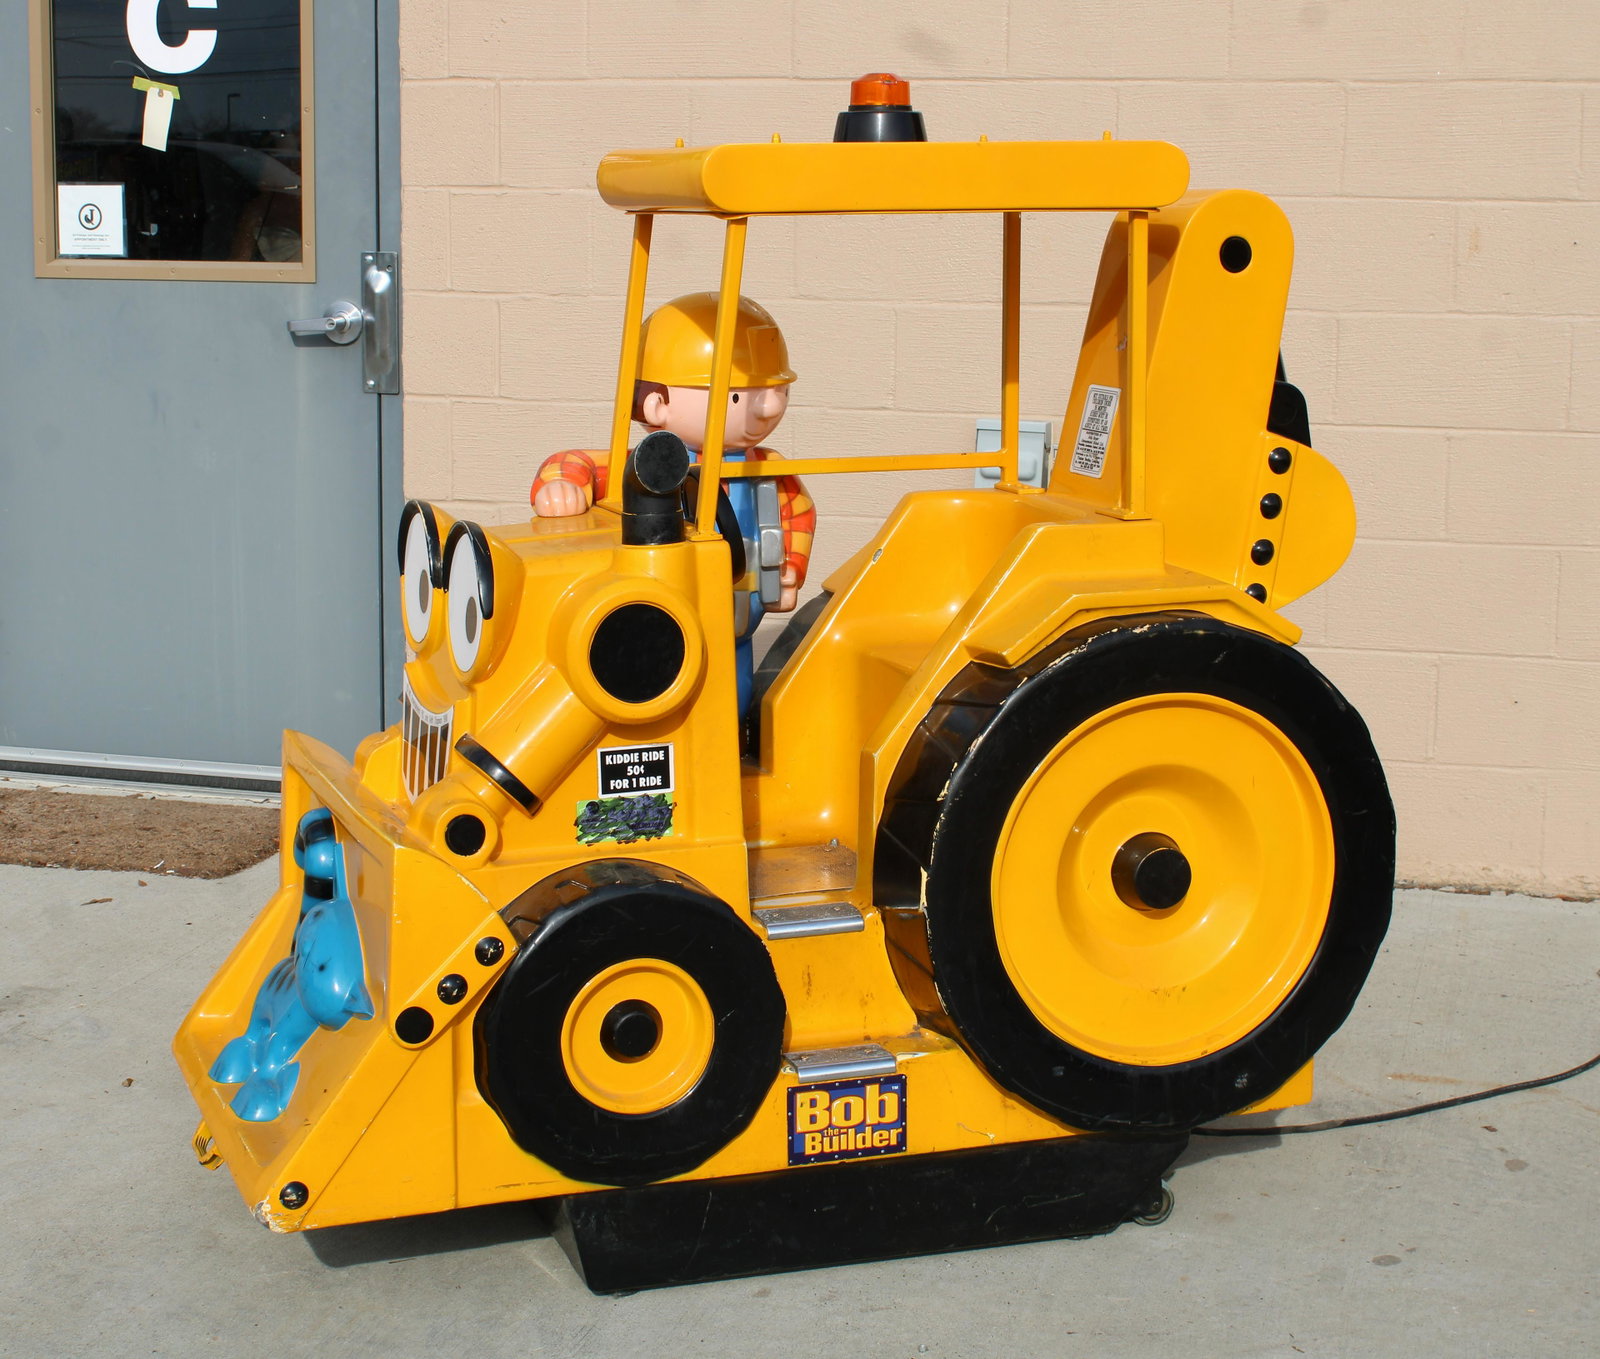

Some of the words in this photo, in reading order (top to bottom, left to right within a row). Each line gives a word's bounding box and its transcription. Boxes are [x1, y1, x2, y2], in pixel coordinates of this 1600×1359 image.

[126, 0, 218, 74] C
[605, 752, 640, 765] KIDDIE
[642, 750, 665, 762] RIDE
[626, 765, 645, 776] 50¢
[610, 779, 629, 790] FOR
[632, 778, 637, 788] 1
[639, 776, 662, 787] RIDE
[795, 1083, 899, 1133] Bob
[823, 1127, 839, 1136] the
[804, 1126, 903, 1156] Builder
